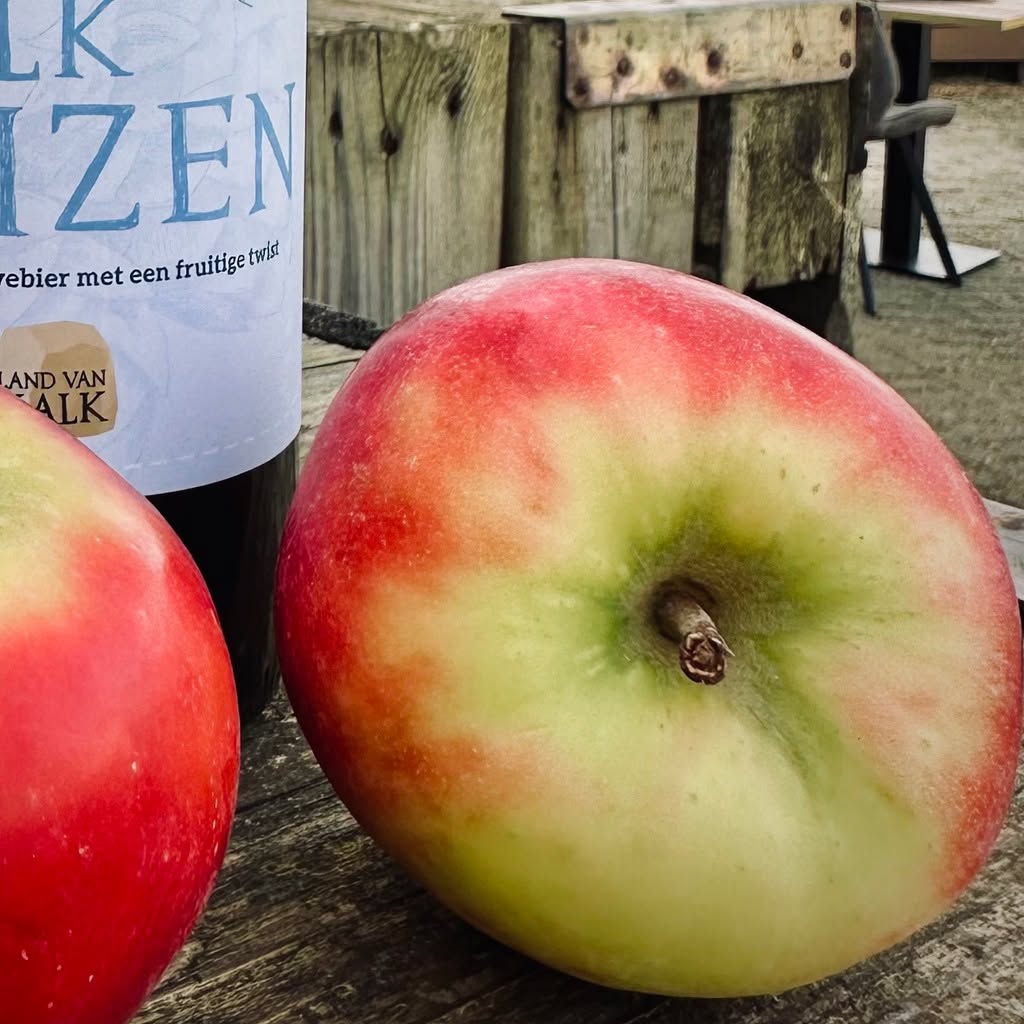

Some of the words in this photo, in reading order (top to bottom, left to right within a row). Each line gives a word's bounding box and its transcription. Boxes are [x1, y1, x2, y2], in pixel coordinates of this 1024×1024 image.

[76, 266, 124, 287] met
[129, 266, 171, 284] een
[175, 252, 246, 281] fruitige
[248, 239, 280, 266] twist
[62, 368, 106, 389] VAN
[16, 390, 109, 425] ALK
